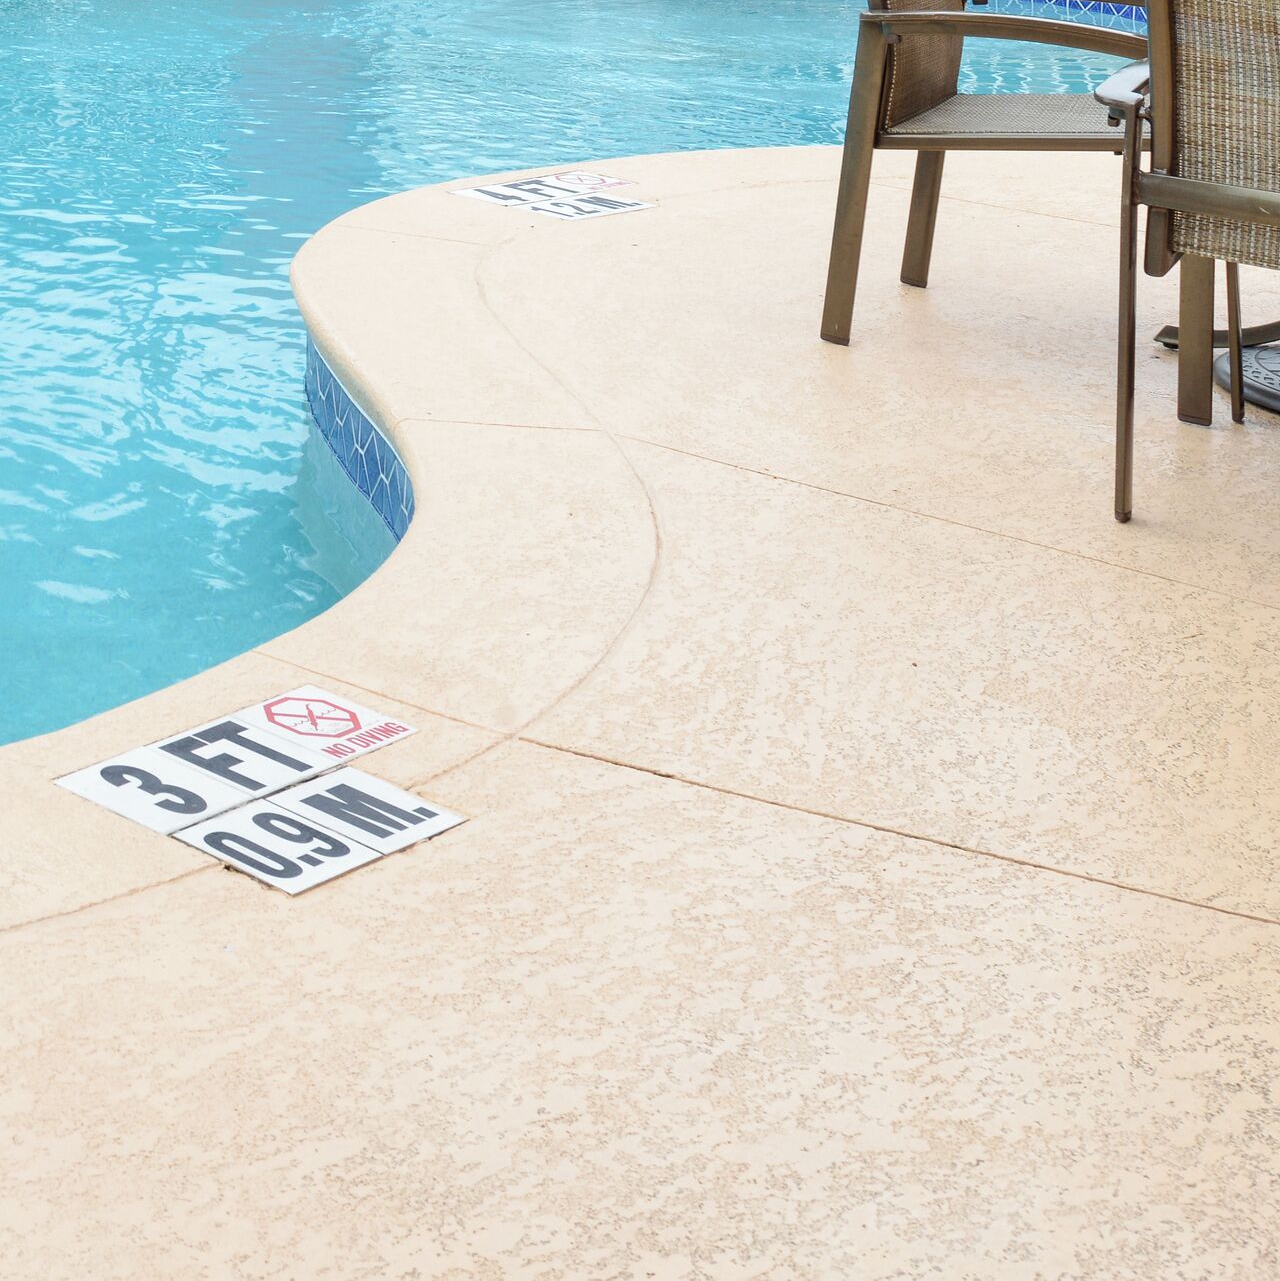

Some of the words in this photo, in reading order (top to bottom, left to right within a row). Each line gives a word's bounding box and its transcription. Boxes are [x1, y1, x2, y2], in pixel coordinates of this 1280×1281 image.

[473, 188, 528, 202] 4
[502, 180, 578, 198] FT
[100, 764, 209, 815] 3
[158, 719, 315, 792] FT
[320, 743, 357, 759] NO
[345, 722, 410, 748] DIVING
[203, 811, 351, 879] 0.9
[298, 783, 439, 839] M.
